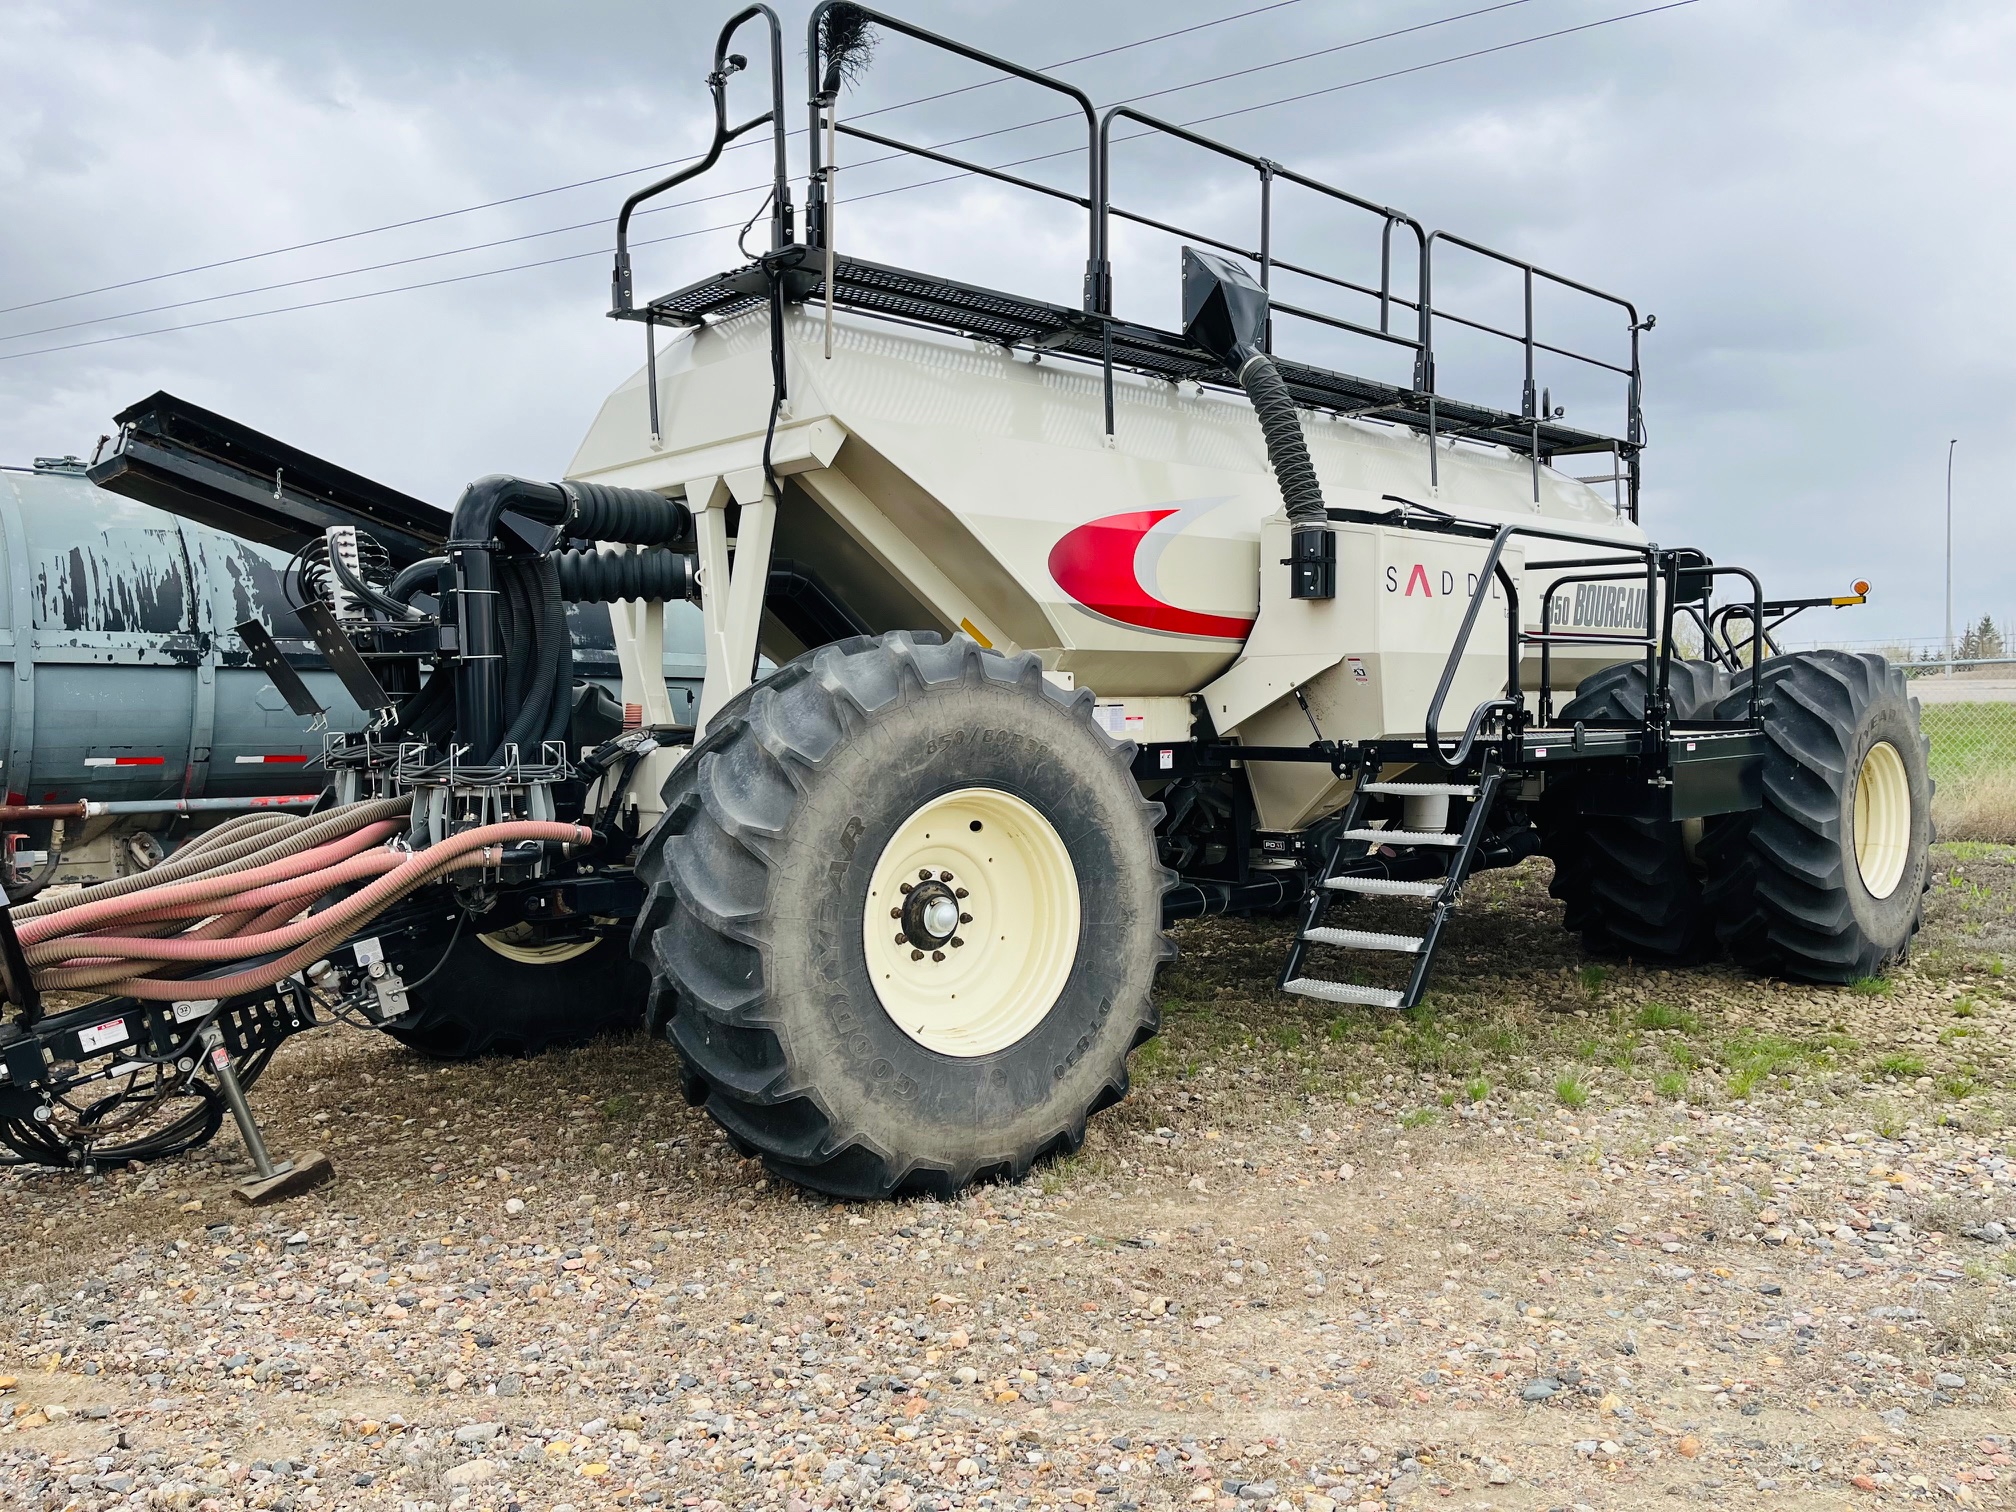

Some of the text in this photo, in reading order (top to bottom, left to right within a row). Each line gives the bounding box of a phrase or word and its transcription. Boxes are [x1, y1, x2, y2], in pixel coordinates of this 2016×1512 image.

[1573, 583, 1659, 629] BOURGAU
[817, 815, 919, 1101] GOODYEAR
[1053, 995, 1112, 1080] DT830
